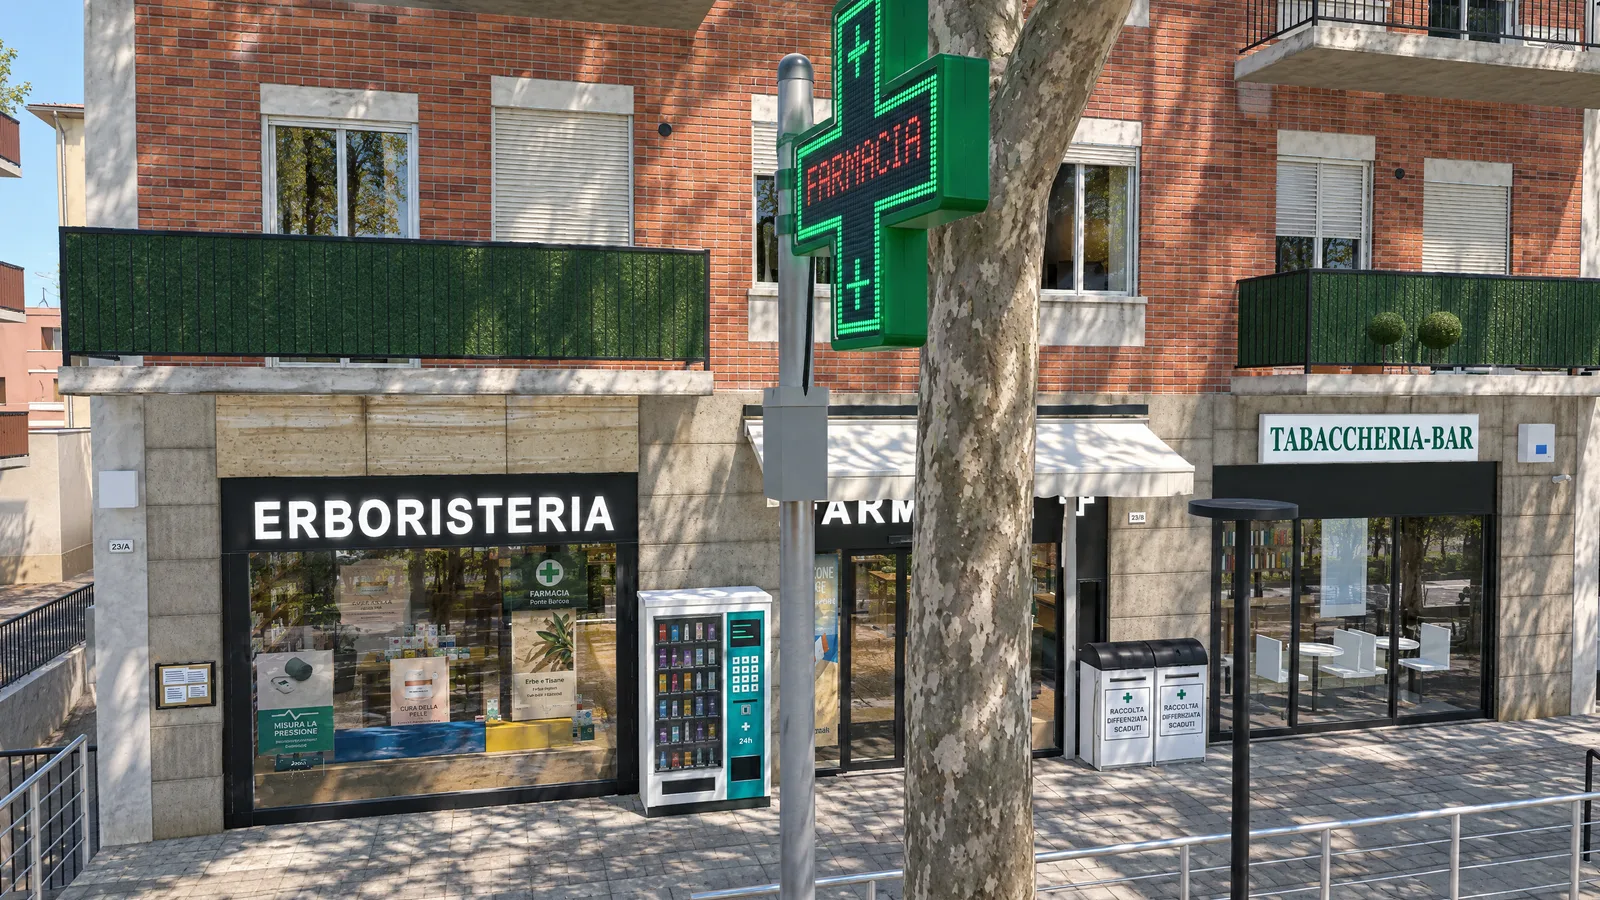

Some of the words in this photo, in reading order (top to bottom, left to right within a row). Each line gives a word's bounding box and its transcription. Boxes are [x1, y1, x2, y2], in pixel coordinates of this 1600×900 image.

[807, 115, 922, 206] FARMACIA
[1270, 426, 1474, 451] TABACCHERIA-BAR
[254, 496, 615, 540] ERBORISTERIA
[111, 543, 130, 551] 23/A
[529, 589, 570, 598] FARMACIA
[1110, 706, 1144, 714] RACCOLTA
[274, 721, 305, 729] MISURA
[274, 727, 318, 737] PRESSIONE
